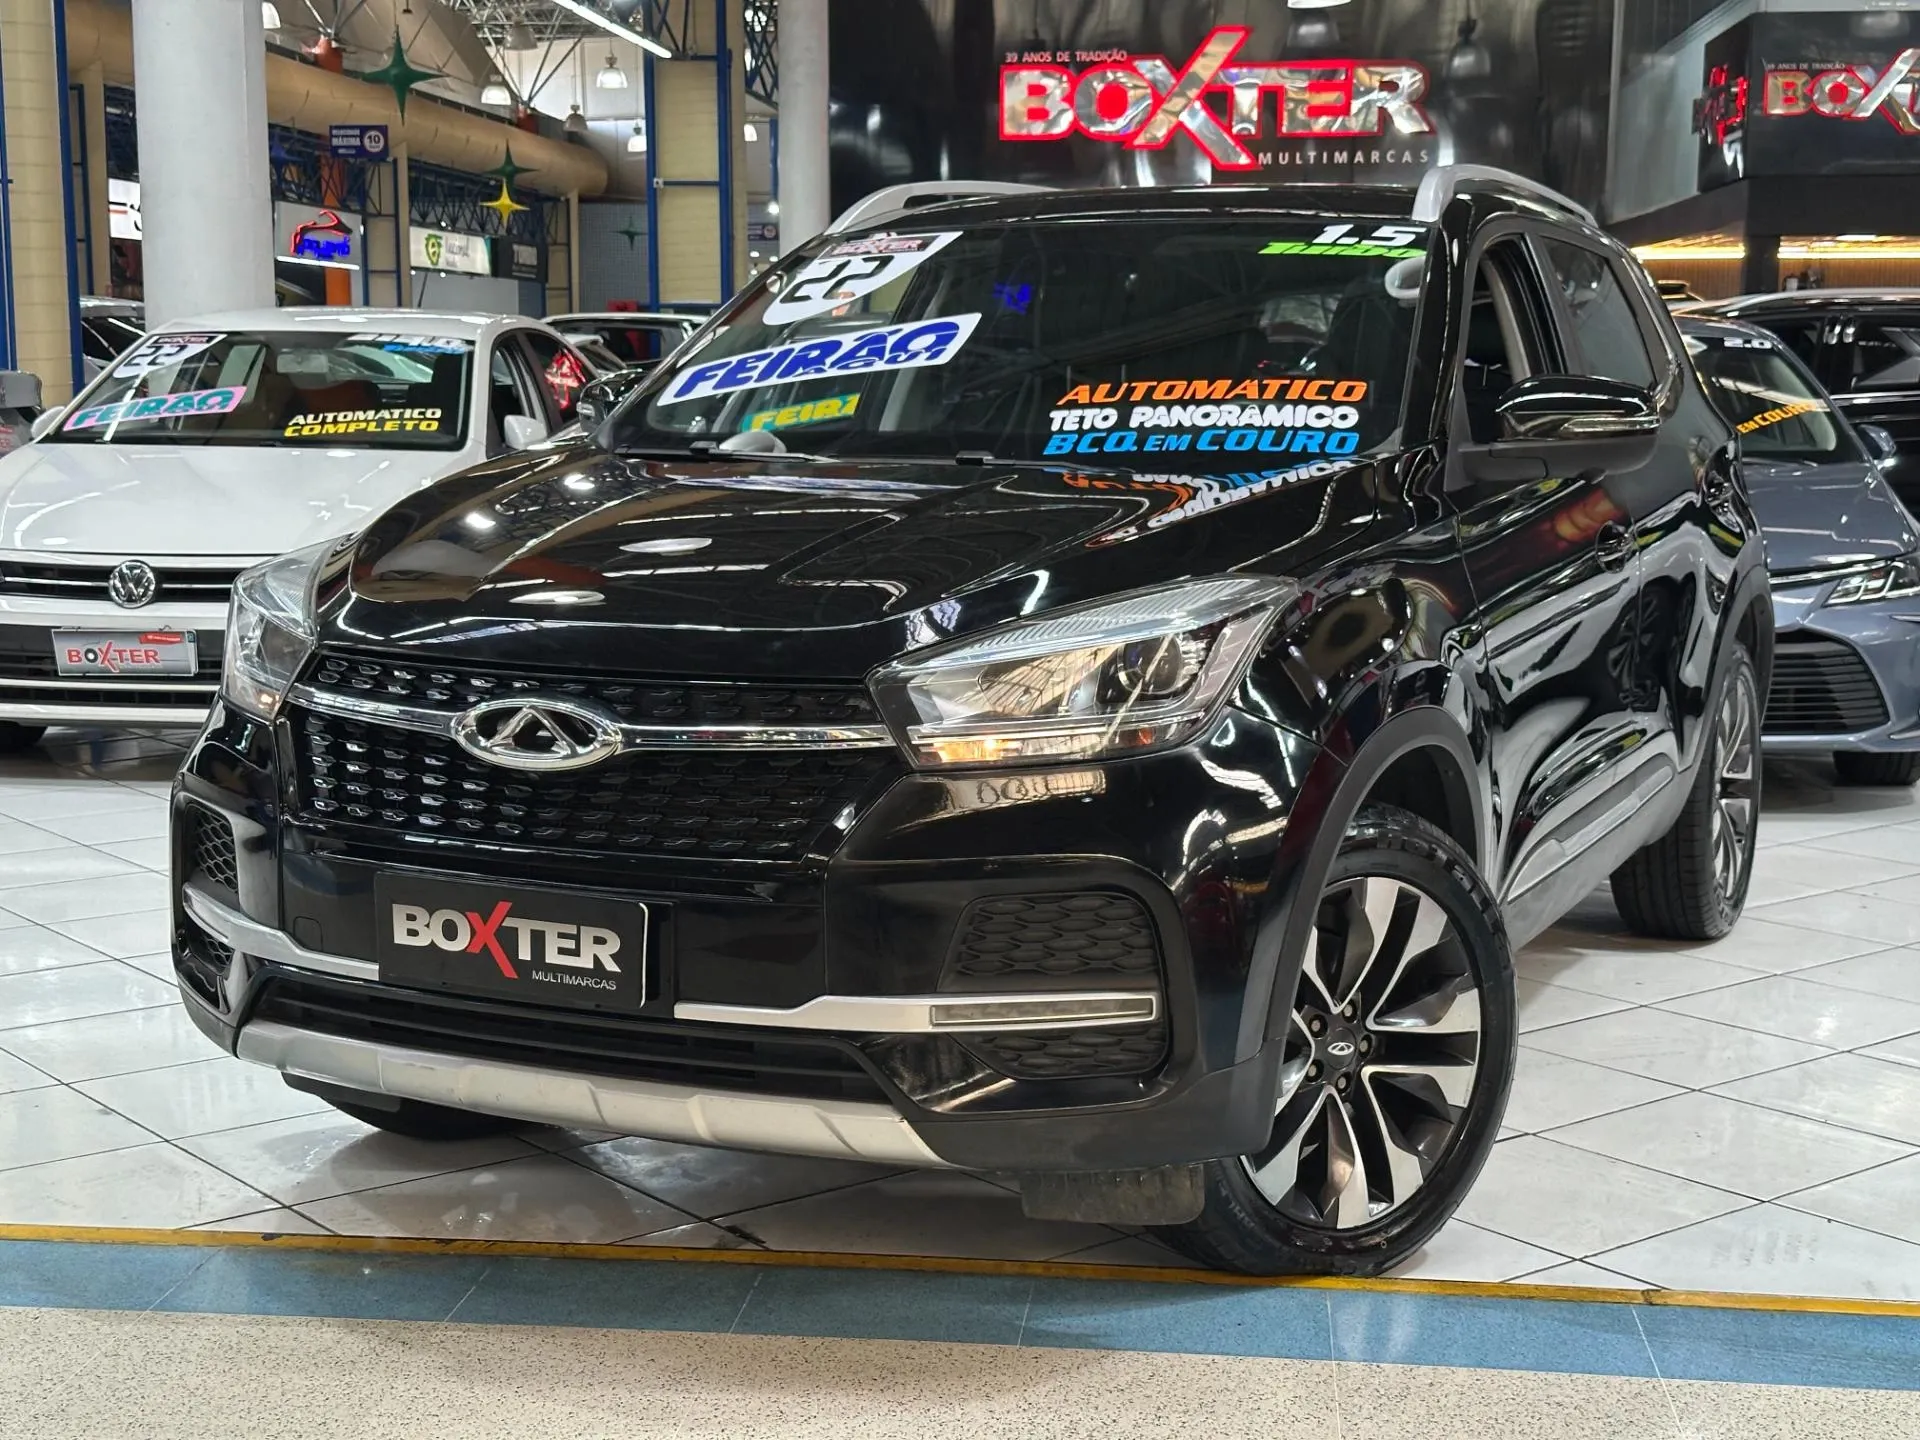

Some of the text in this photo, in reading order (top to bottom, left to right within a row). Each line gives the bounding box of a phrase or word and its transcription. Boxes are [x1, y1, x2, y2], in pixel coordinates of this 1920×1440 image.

[1004, 48, 1128, 63] 39 ANOS DE TRADIÇÃO
[1000, 25, 1438, 171] BOXTER
[366, 134, 381, 144] 10
[1258, 150, 1430, 165] MULTIMARCAS
[1312, 223, 1427, 247] 1.5
[779, 255, 895, 304] 22
[1723, 336, 1772, 350] 2.0
[123, 344, 188, 367] 22
[283, 420, 439, 437] COMPLETO
[1049, 404, 1360, 432] TETO PANORÂMICO
[1736, 420, 1757, 433] EM
[1143, 433, 1192, 452] EM
[1196, 429, 1360, 454] COURO
[66, 640, 162, 673] BOXTER
[392, 899, 622, 979] BOXTER
[532, 969, 617, 990] MULTIMARCAS
